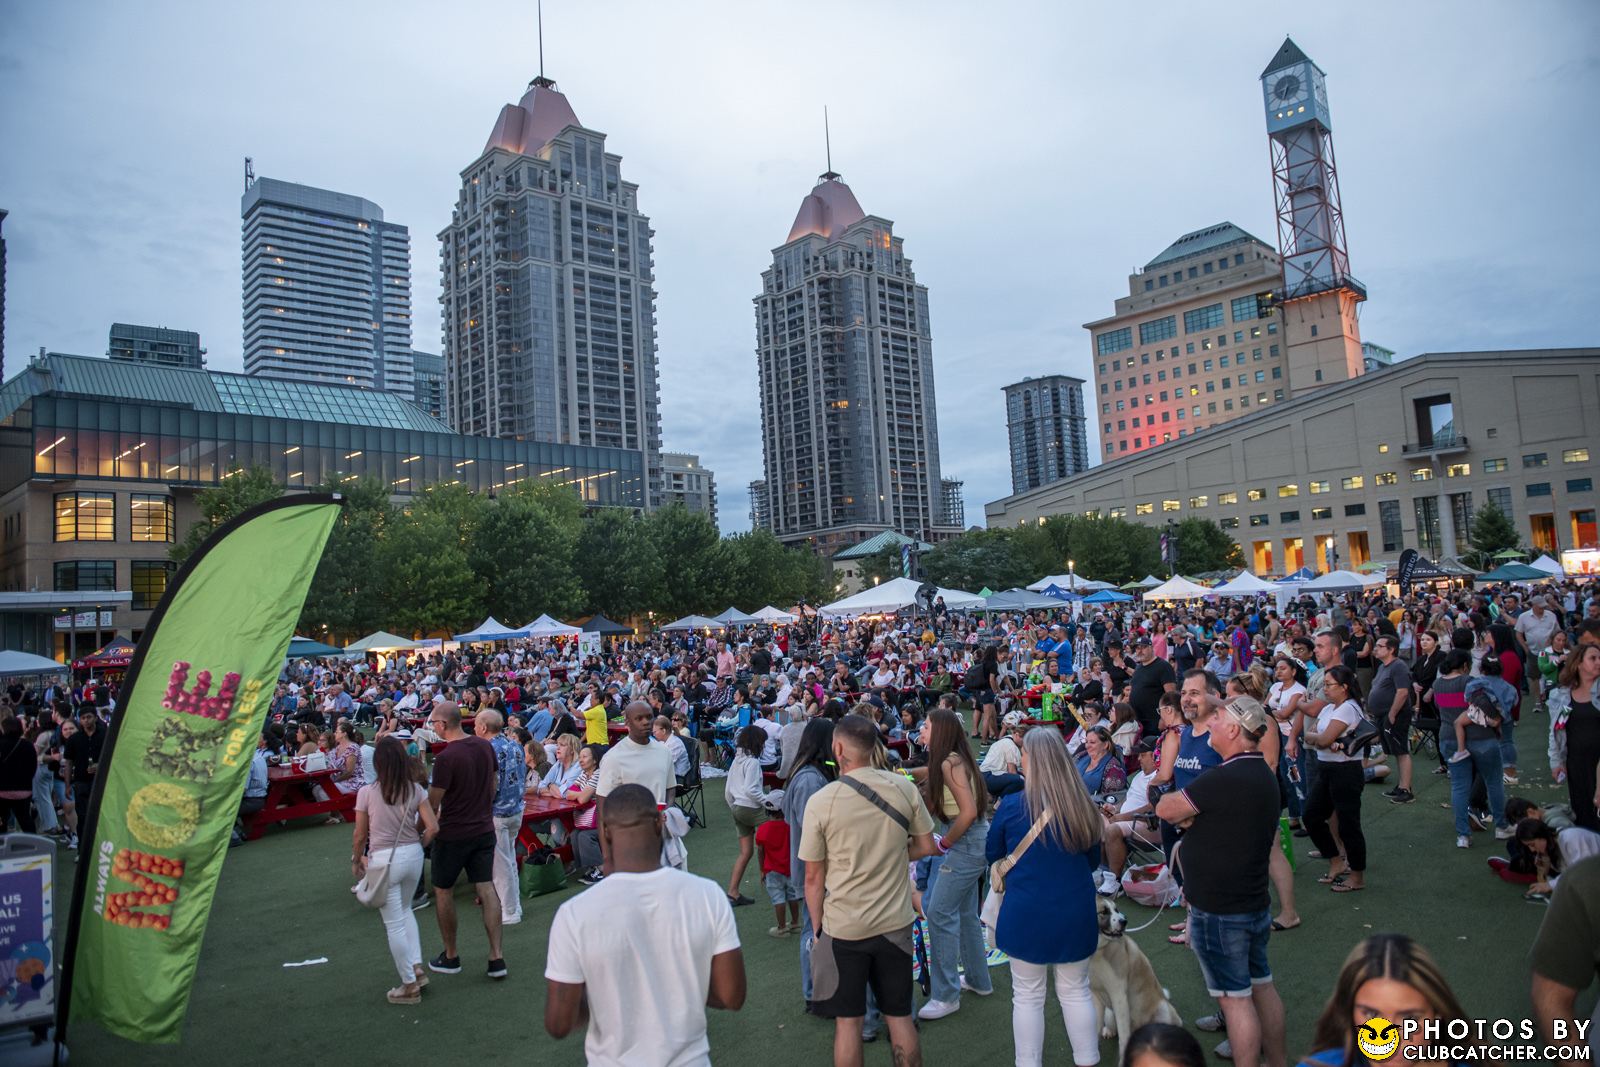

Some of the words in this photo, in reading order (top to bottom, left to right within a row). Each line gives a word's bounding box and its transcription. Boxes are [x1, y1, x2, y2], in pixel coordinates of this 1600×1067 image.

[1401, 553, 1418, 587] CHURROS
[222, 728, 248, 767] FOR
[235, 679, 263, 725] LESS
[1174, 754, 1202, 770] ench.
[104, 661, 241, 931] MORE
[93, 840, 114, 915] ALWAYS
[2, 894, 22, 905] US
[0, 924, 16, 934] IVE
